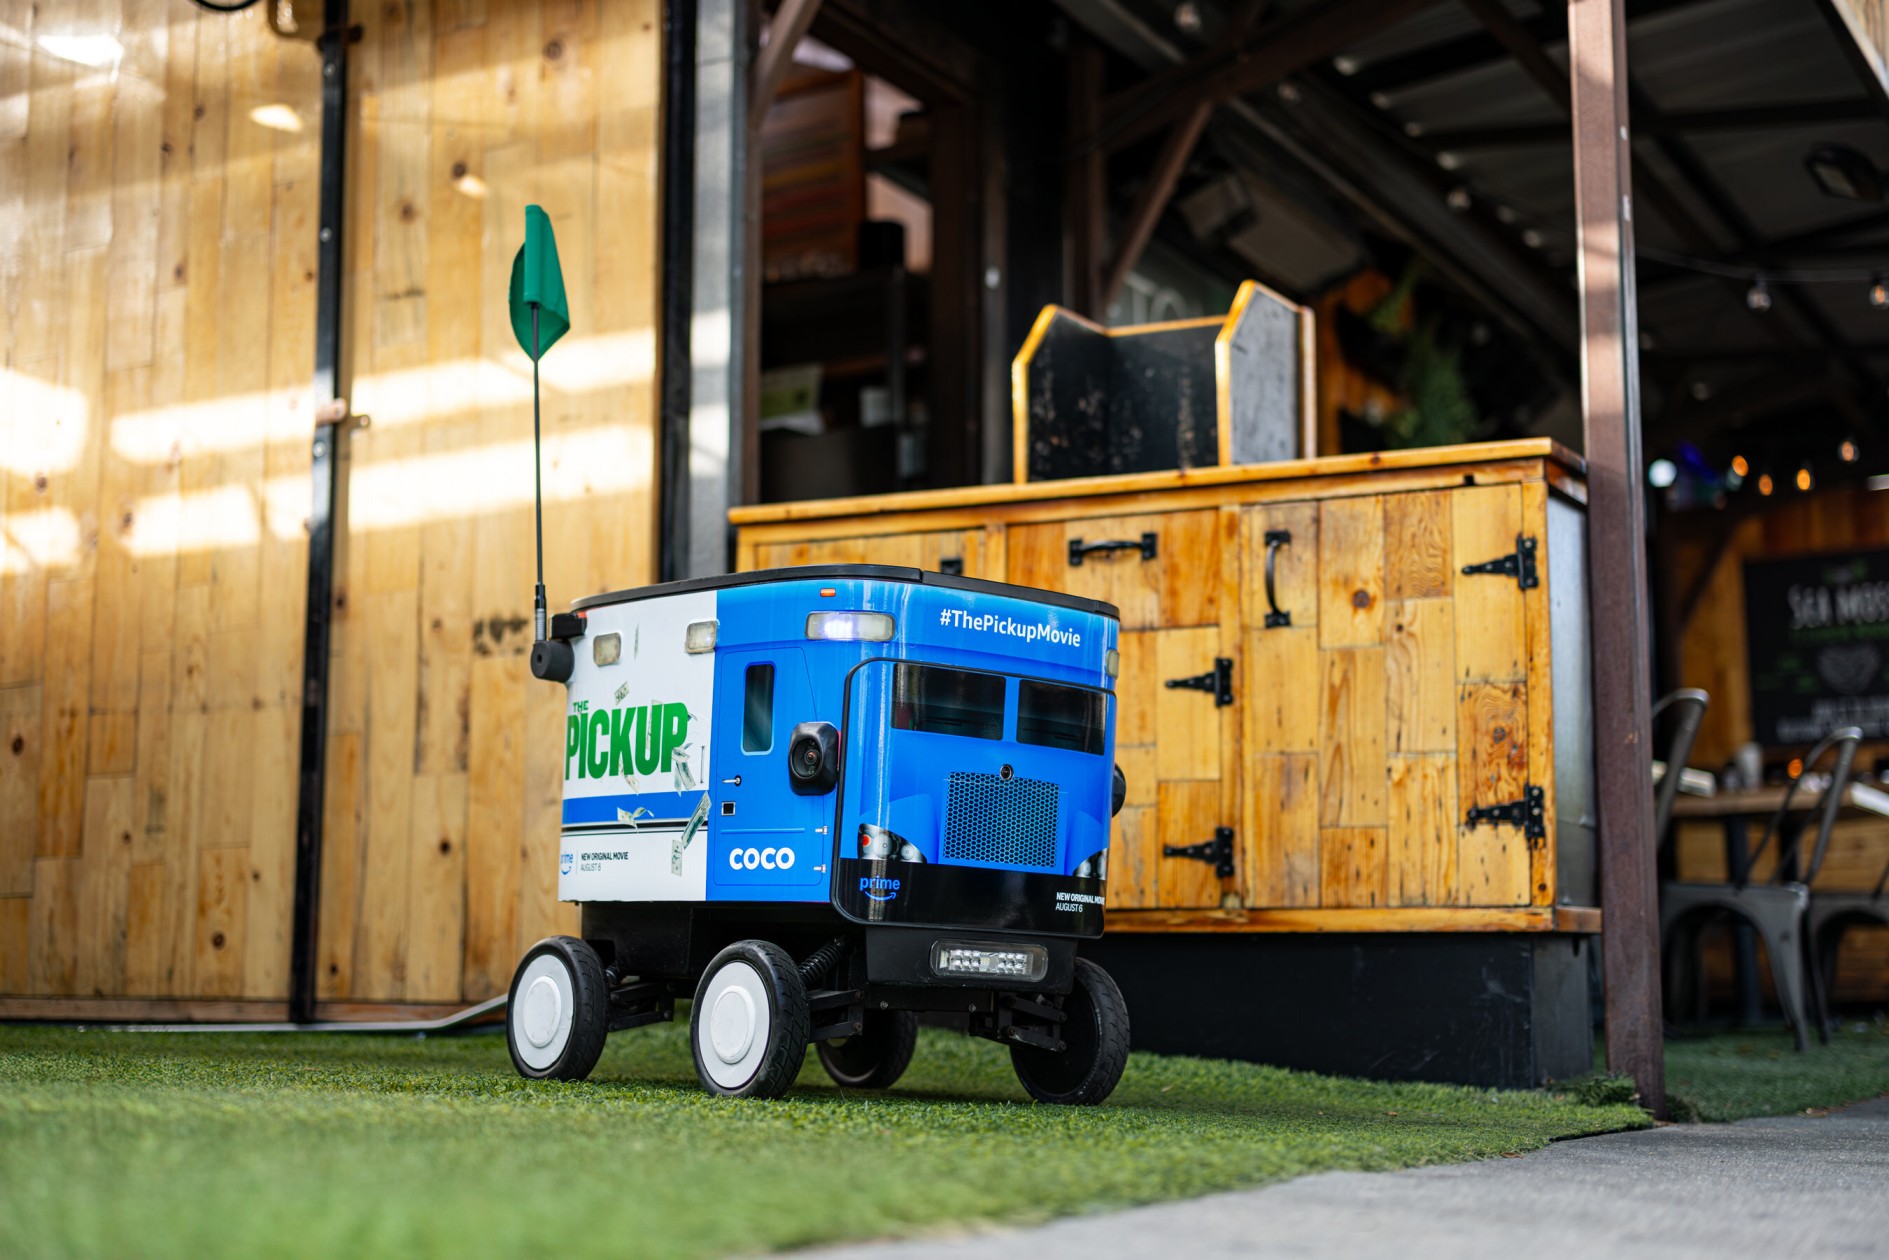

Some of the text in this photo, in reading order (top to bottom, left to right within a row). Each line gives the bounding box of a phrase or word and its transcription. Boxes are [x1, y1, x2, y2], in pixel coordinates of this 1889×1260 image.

[940, 608, 1081, 647] #ThePickupMovie
[573, 700, 588, 713] THE
[565, 702, 688, 780] PICKUP
[581, 851, 629, 861] NEW ORIGINAL MOVIE
[580, 863, 597, 871] AUGUST
[859, 875, 900, 891] prime
[1056, 892, 1070, 901] NEW
[1070, 893, 1094, 904] ORIGINAL
[1055, 902, 1078, 912] AUGUST
